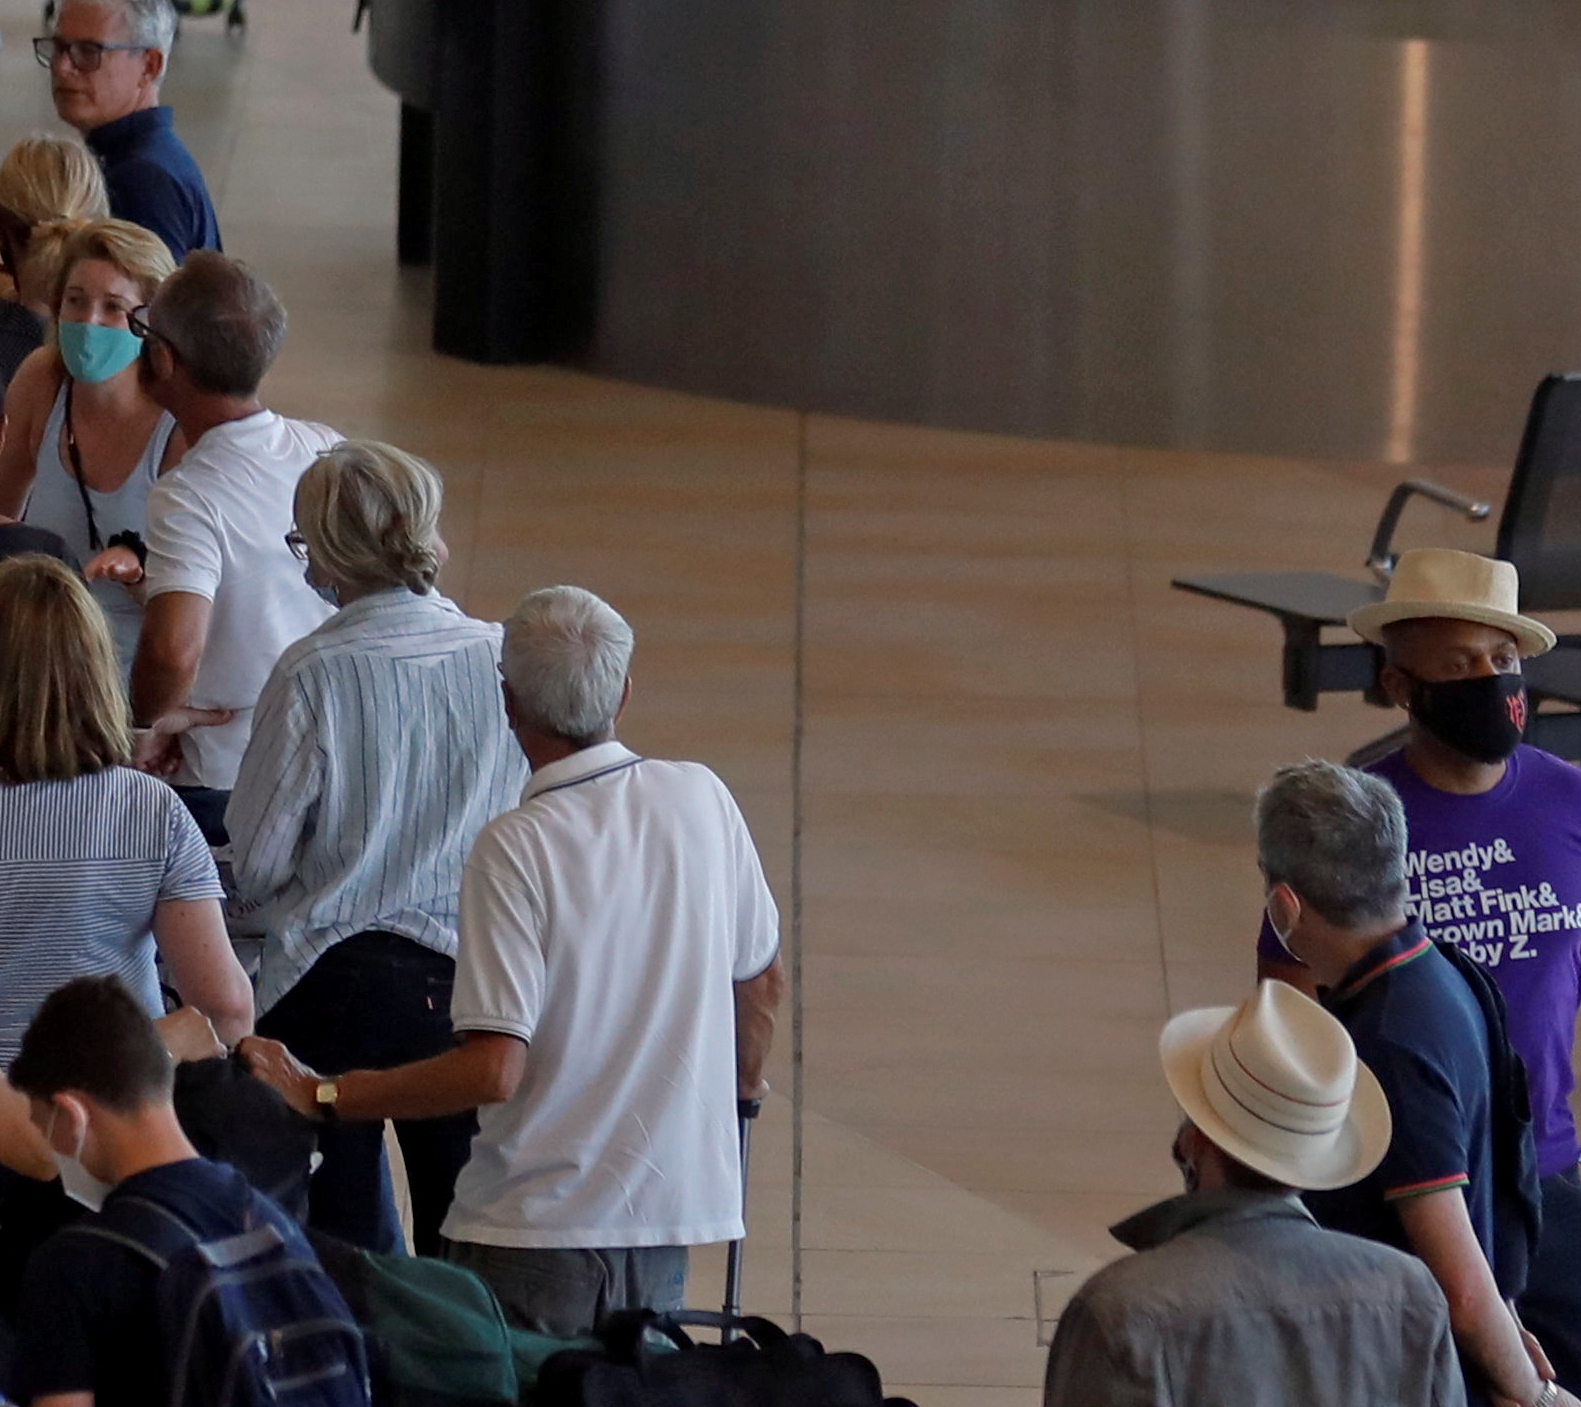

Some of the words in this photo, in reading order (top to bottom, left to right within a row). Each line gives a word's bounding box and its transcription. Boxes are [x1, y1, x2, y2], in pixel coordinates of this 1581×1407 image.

[1404, 838, 1516, 878] Wendy&
[1404, 895, 1477, 924] Matt
[1479, 882, 1560, 915] Fink&
[1405, 868, 1484, 903] Lisa&
[1424, 917, 1505, 944] rown
[1509, 935, 1538, 960] Z.
